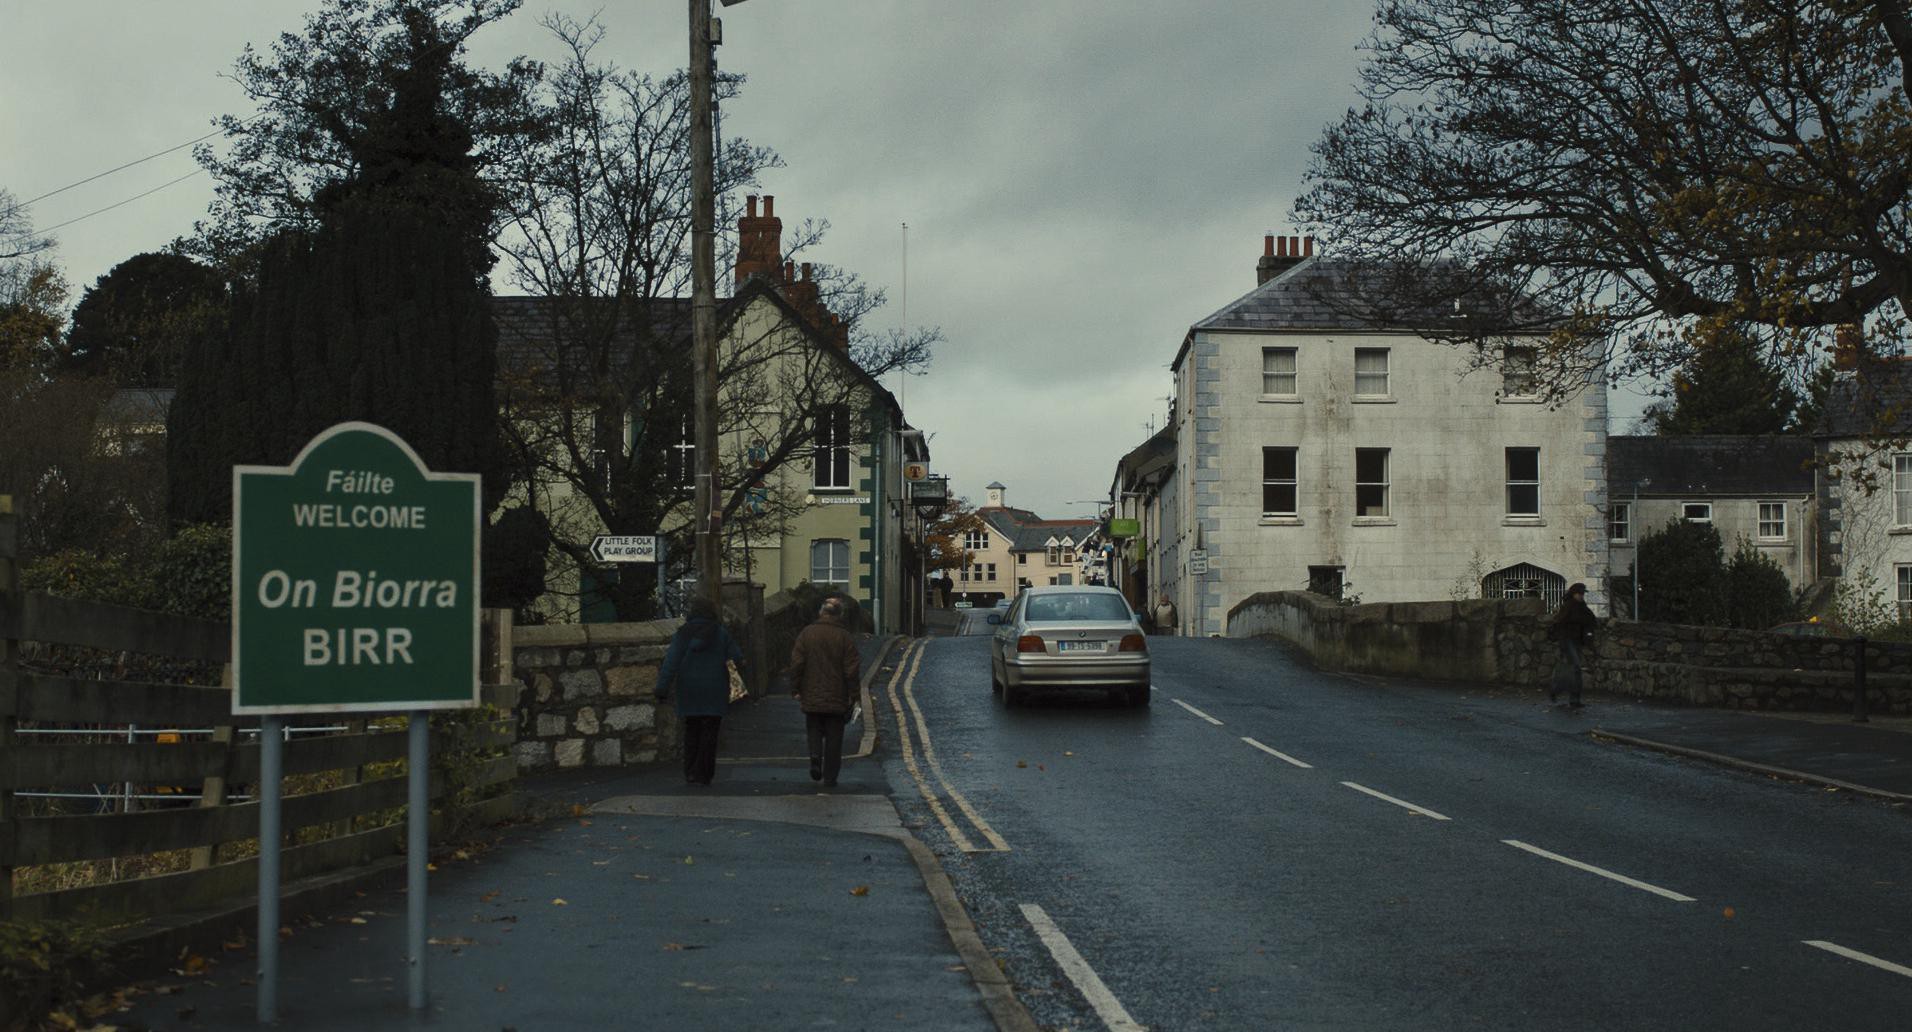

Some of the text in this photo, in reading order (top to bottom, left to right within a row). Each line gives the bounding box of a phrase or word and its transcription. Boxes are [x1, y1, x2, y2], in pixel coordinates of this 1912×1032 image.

[326, 470, 394, 494] Fáilte
[293, 504, 426, 528] WELCOME
[604, 547, 653, 555] PLAY GROUP
[605, 537, 652, 545] LITTLE FOLK
[258, 570, 457, 608] On Biorra
[304, 628, 413, 666] BIRR
